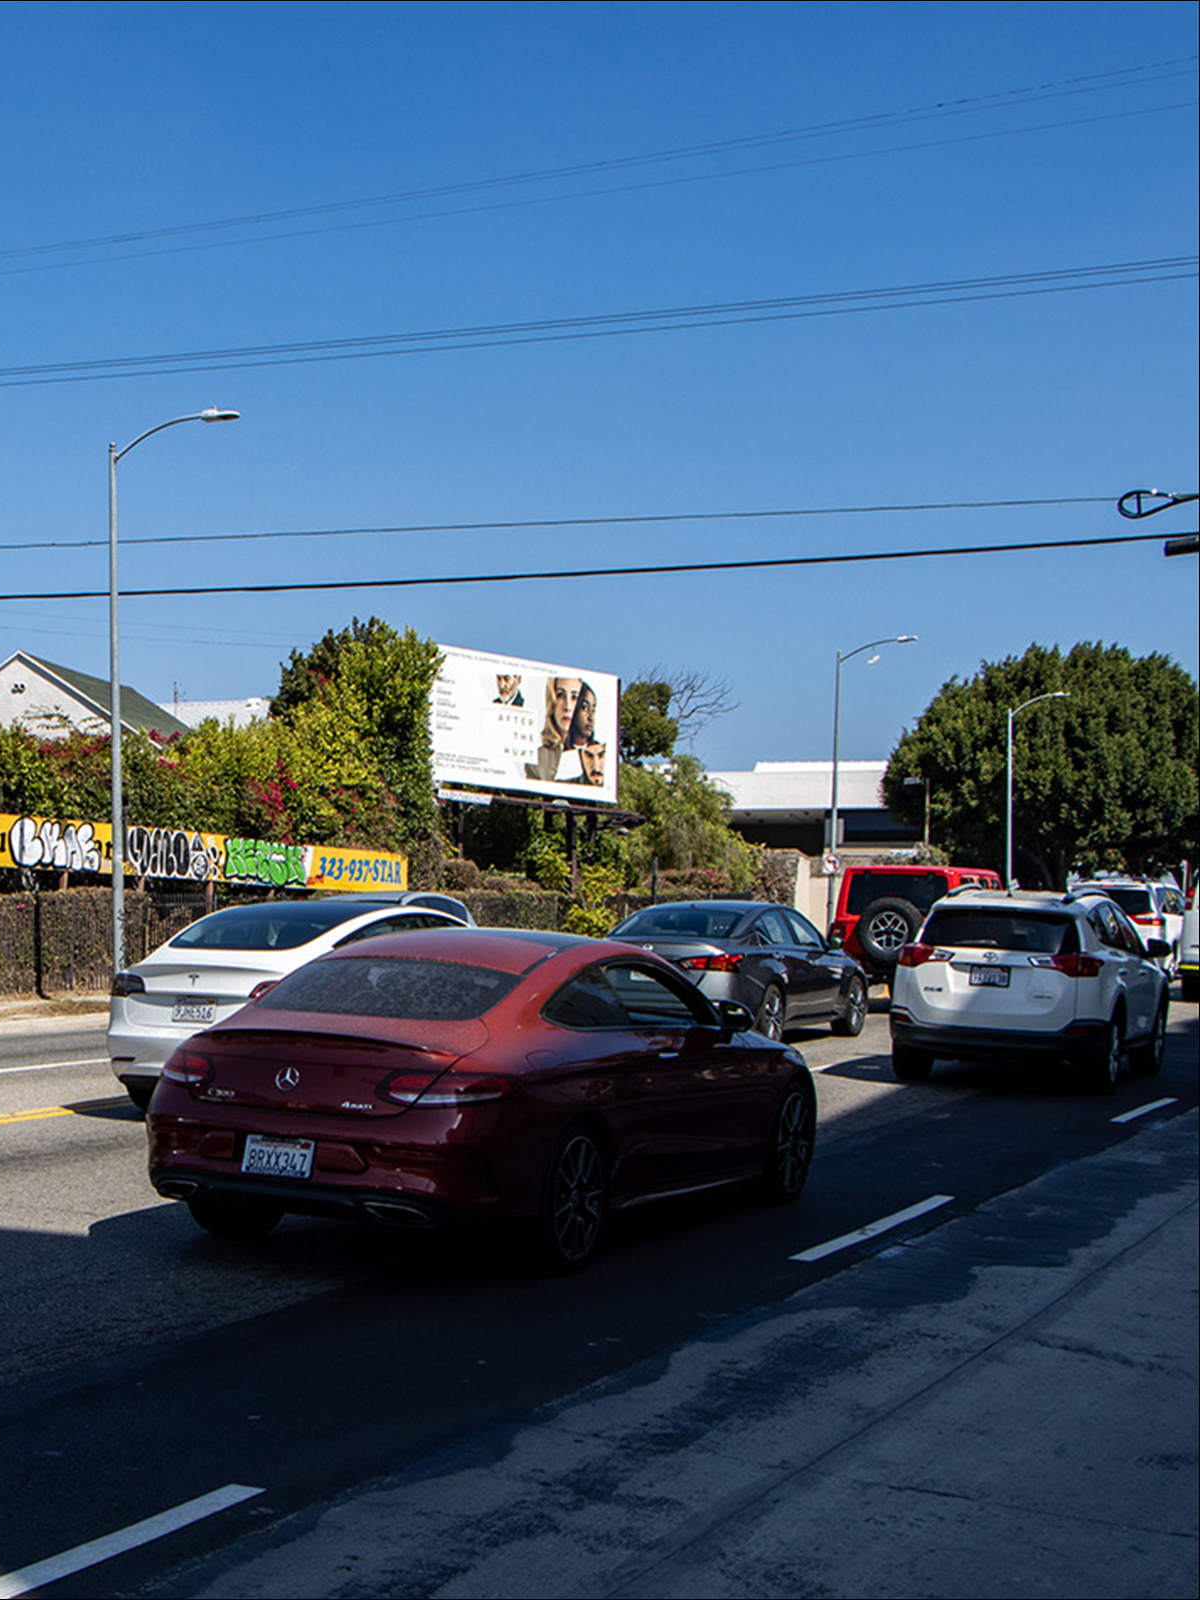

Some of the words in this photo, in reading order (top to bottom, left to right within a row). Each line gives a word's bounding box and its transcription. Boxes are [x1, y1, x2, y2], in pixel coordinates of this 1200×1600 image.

[497, 713, 533, 726] AFTER
[513, 731, 533, 743] THE
[319, 856, 402, 884] 323-937-STAR
[248, 1148, 307, 1173] 8RXX347
